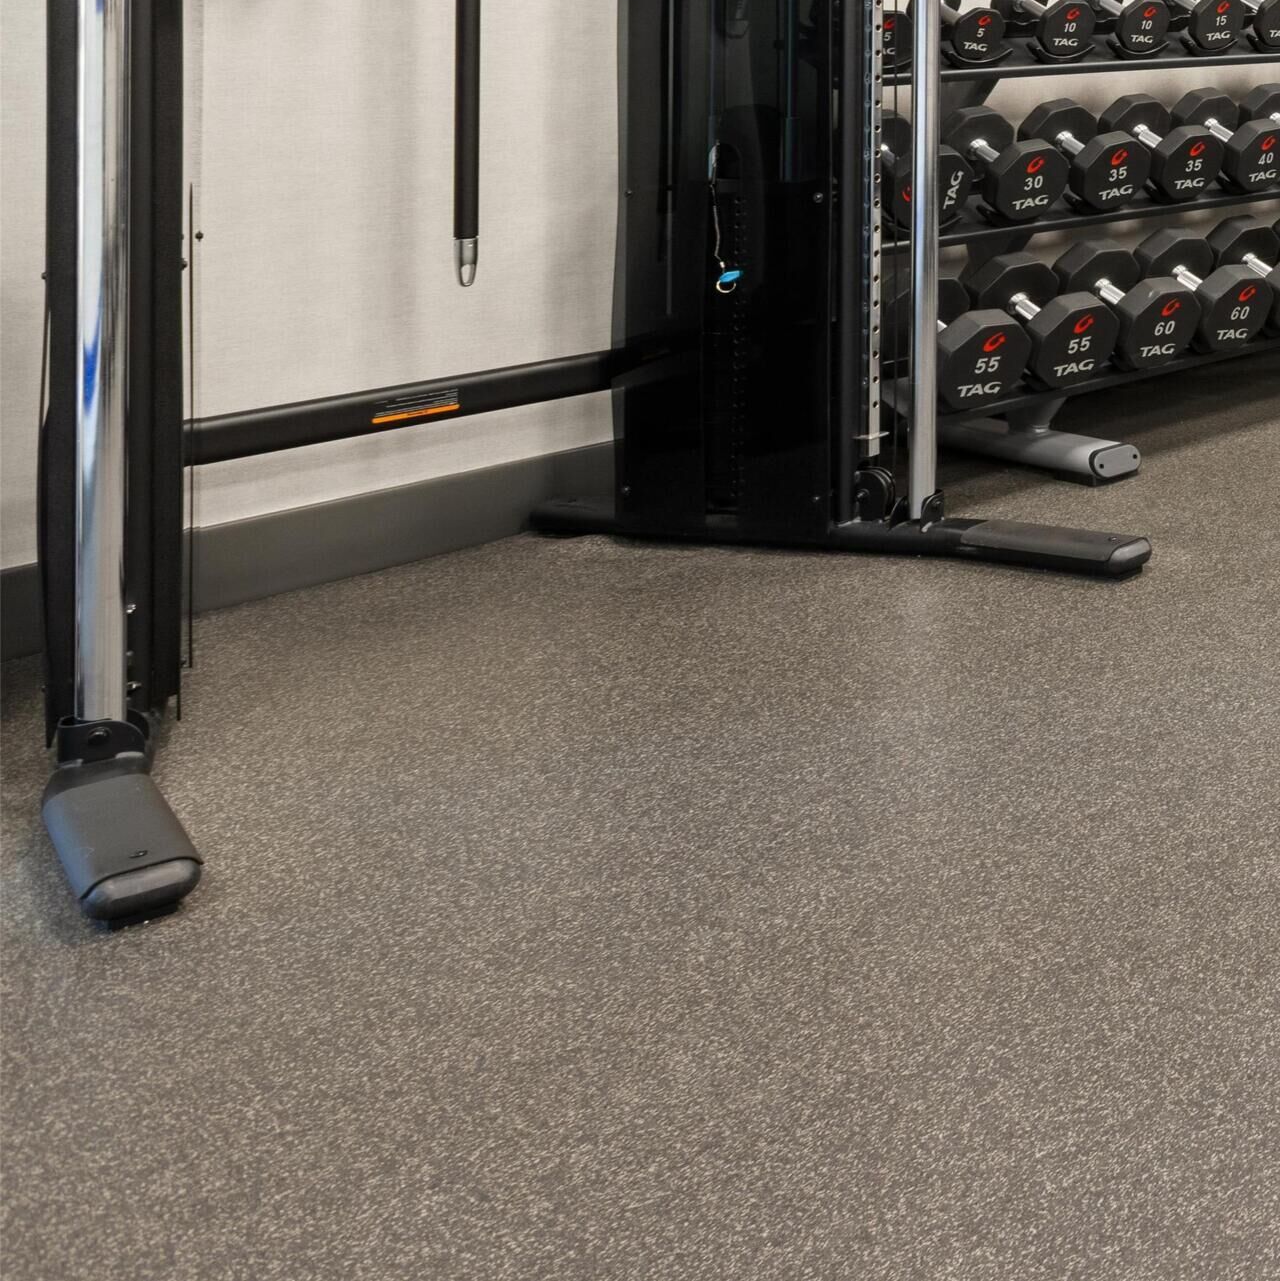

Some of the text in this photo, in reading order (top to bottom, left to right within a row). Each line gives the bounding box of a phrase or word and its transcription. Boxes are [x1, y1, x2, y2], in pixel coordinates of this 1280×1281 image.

[1064, 22, 1077, 33] 10
[1141, 19, 1153, 30] 10
[1215, 14, 1228, 27] 15
[976, 27, 986, 38] 5
[1130, 34, 1154, 44] TAG
[1205, 30, 1231, 41] TAG
[963, 41, 988, 52] TAG
[1052, 37, 1079, 47] TAG
[1185, 158, 1203, 173] 35
[1257, 151, 1274, 165] 40
[1108, 165, 1128, 182] 35
[1248, 168, 1277, 183] TAG
[942, 170, 965, 210] TAG
[1023, 175, 1044, 191] 30
[1174, 177, 1205, 190] TAG
[1098, 184, 1134, 201] TAG
[1011, 194, 1049, 211] TAG
[1230, 305, 1251, 321] 60
[1154, 320, 1176, 336] 60
[1216, 327, 1249, 341] TAG
[1067, 335, 1092, 355] 55
[1139, 343, 1176, 358] TAG
[974, 355, 1001, 375] 55
[1053, 358, 1095, 377] TAG
[957, 381, 1002, 398] TAG
